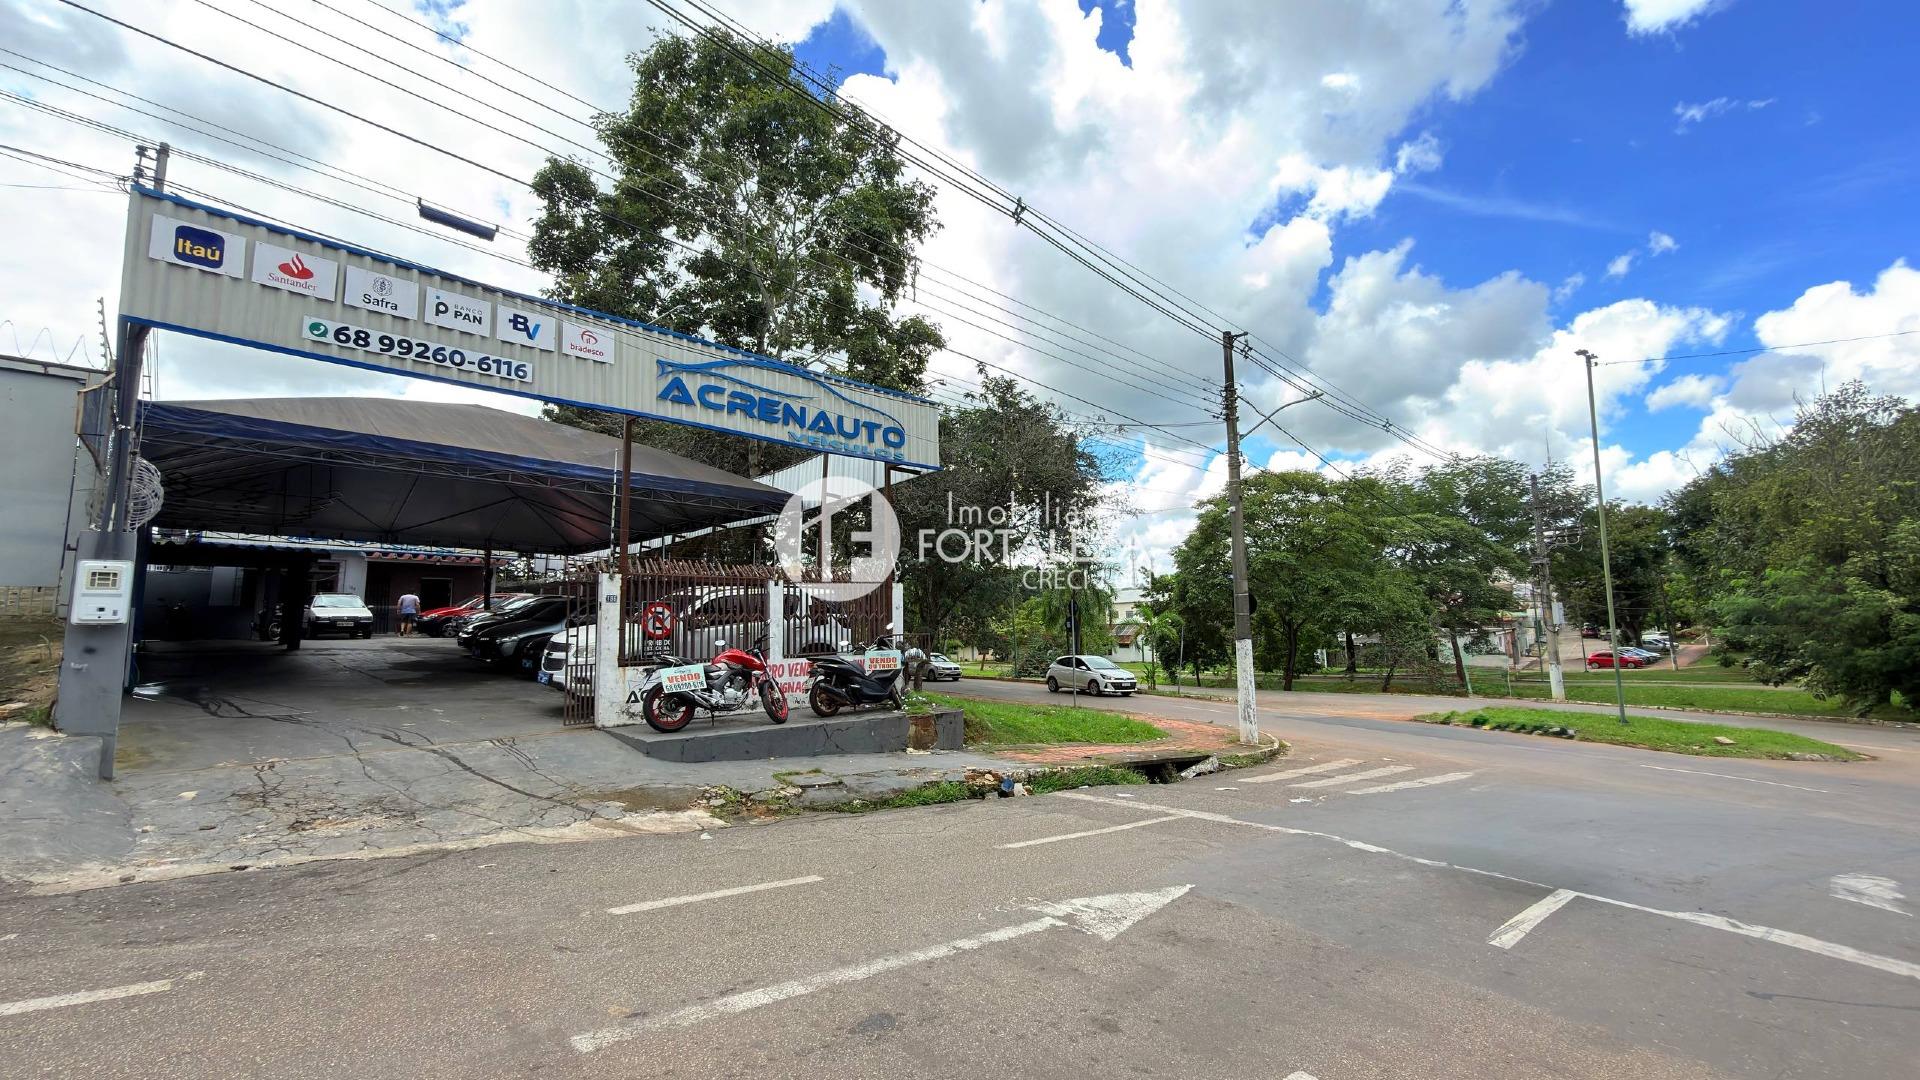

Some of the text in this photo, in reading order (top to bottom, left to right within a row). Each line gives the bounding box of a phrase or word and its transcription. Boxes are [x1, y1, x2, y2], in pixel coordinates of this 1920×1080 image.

[176, 236, 222, 263] Itaú
[268, 272, 318, 292] Santander
[362, 292, 399, 312] Safra
[454, 304, 483, 315] BANCO
[454, 310, 483, 325] PAN
[333, 325, 528, 380] 68 99260-6116
[570, 343, 604, 357] bradesco
[657, 376, 906, 449] ACRENAUTO
[869, 656, 897, 664] VENDO
[667, 673, 701, 684] VENDO
